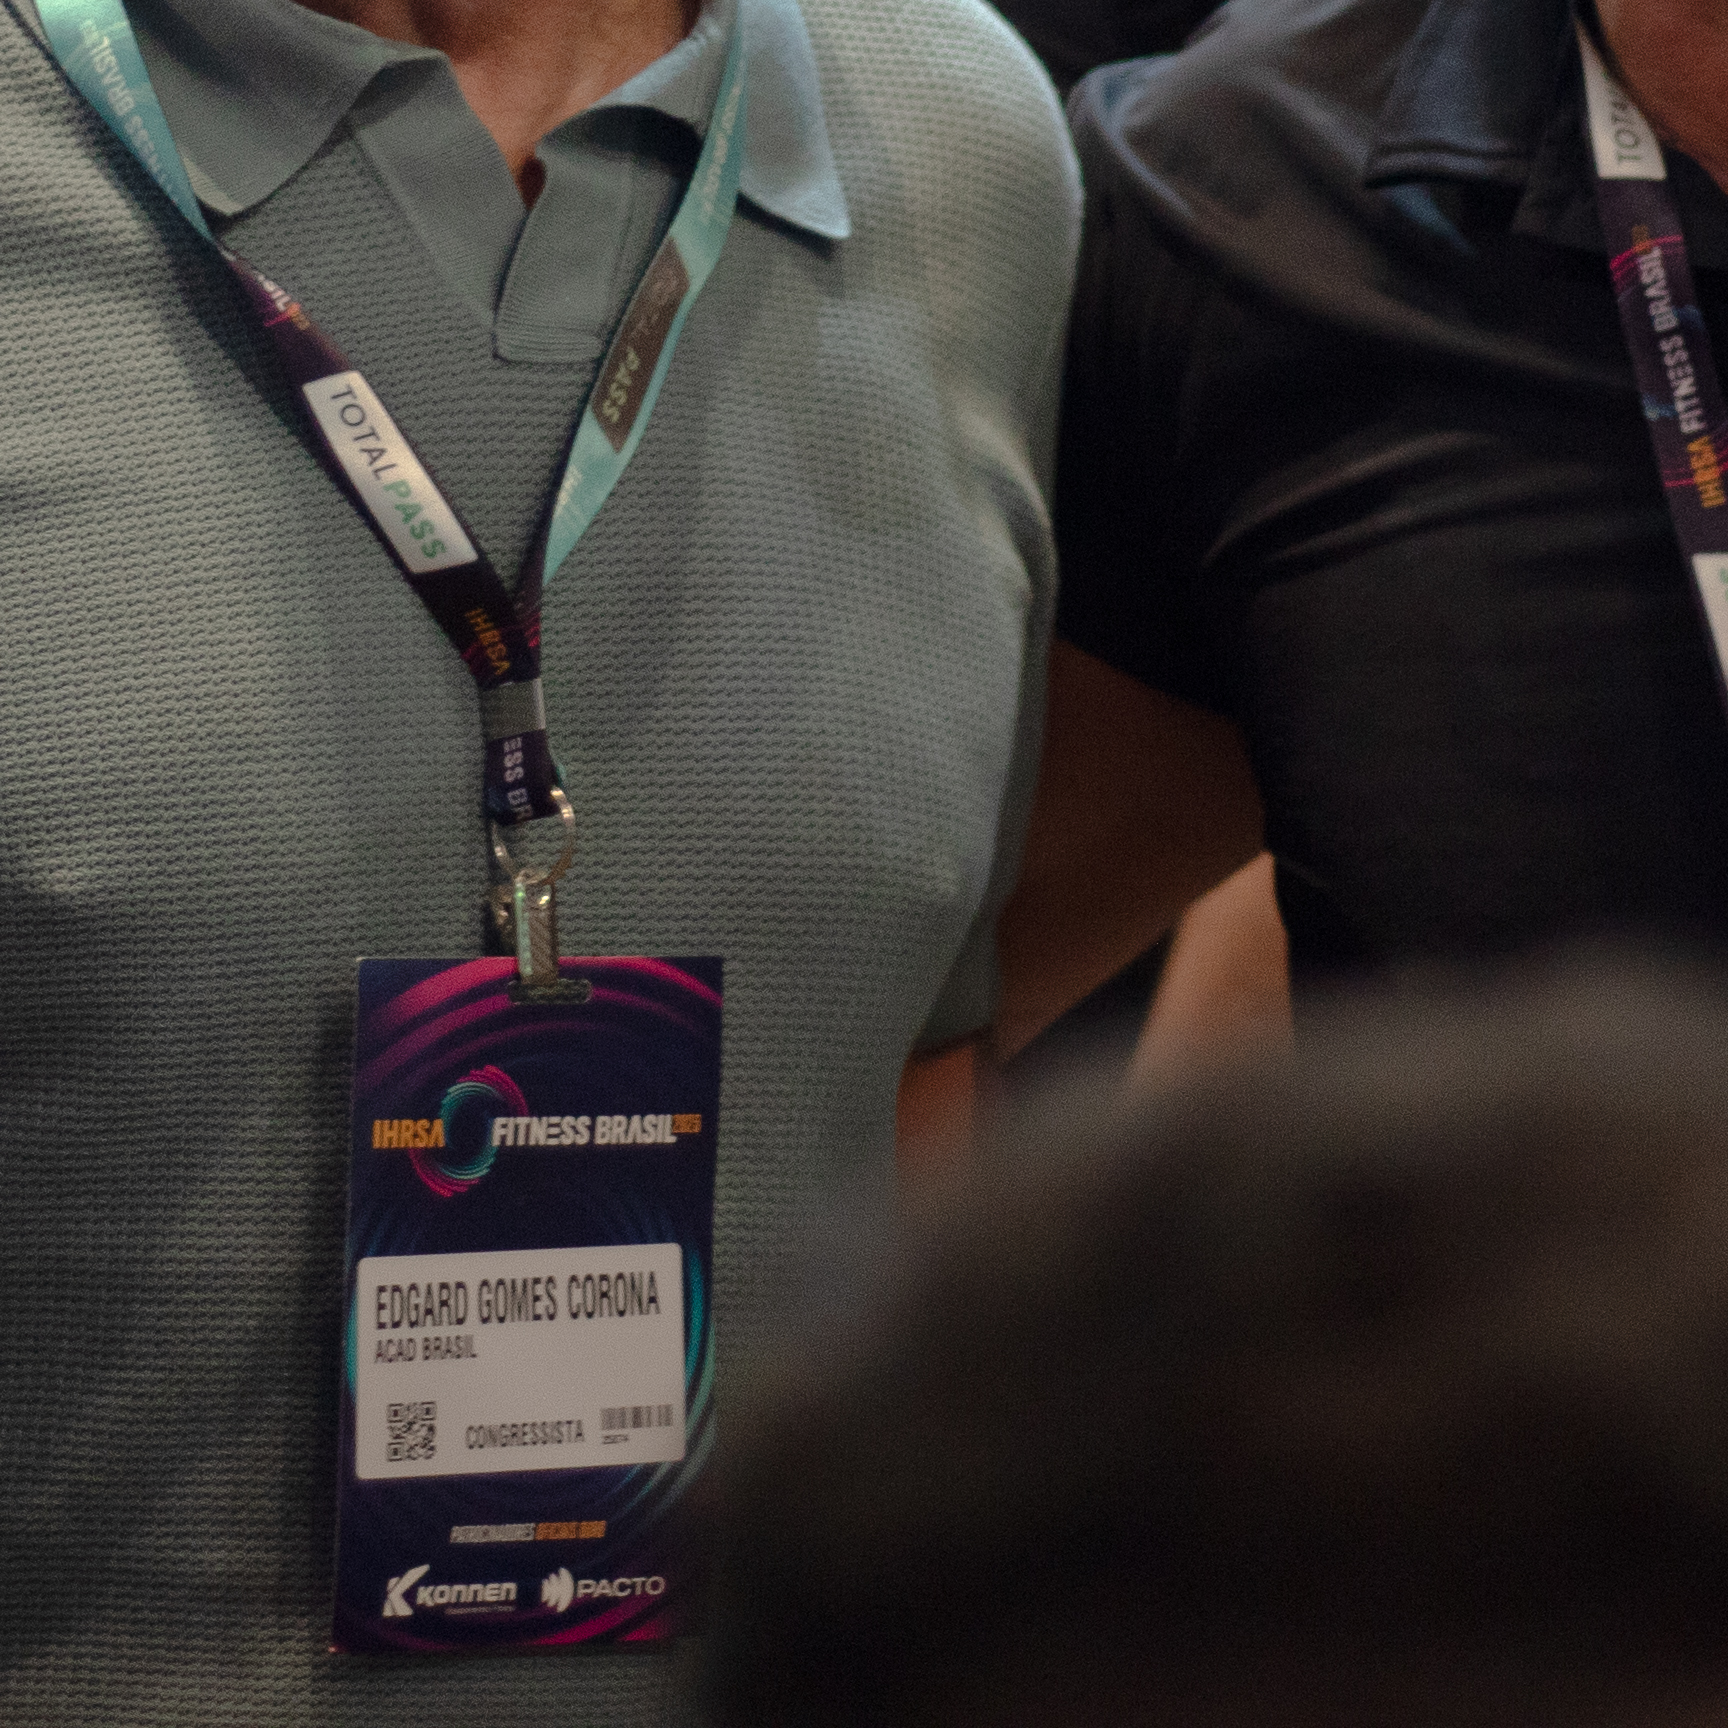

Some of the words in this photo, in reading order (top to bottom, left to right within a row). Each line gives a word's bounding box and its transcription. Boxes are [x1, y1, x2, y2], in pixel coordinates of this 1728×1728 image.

[1638, 246, 1679, 332] BRASIL
[1659, 335, 1706, 434] FITNESS
[330, 384, 447, 559] TOTALPASS
[1687, 435, 1726, 508] IHRSA
[373, 1119, 445, 1149] IHRSA
[491, 1116, 591, 1146] FITNESS
[594, 1114, 677, 1145] BRASIL
[375, 1282, 468, 1330] EDGARD
[478, 1276, 557, 1324] GOMES
[567, 1271, 661, 1320] CORONA
[374, 1338, 416, 1363] ACAD
[422, 1334, 477, 1360] BRASIL
[466, 1420, 585, 1449] CONGRESSISTA
[576, 1576, 666, 1598] PACTO
